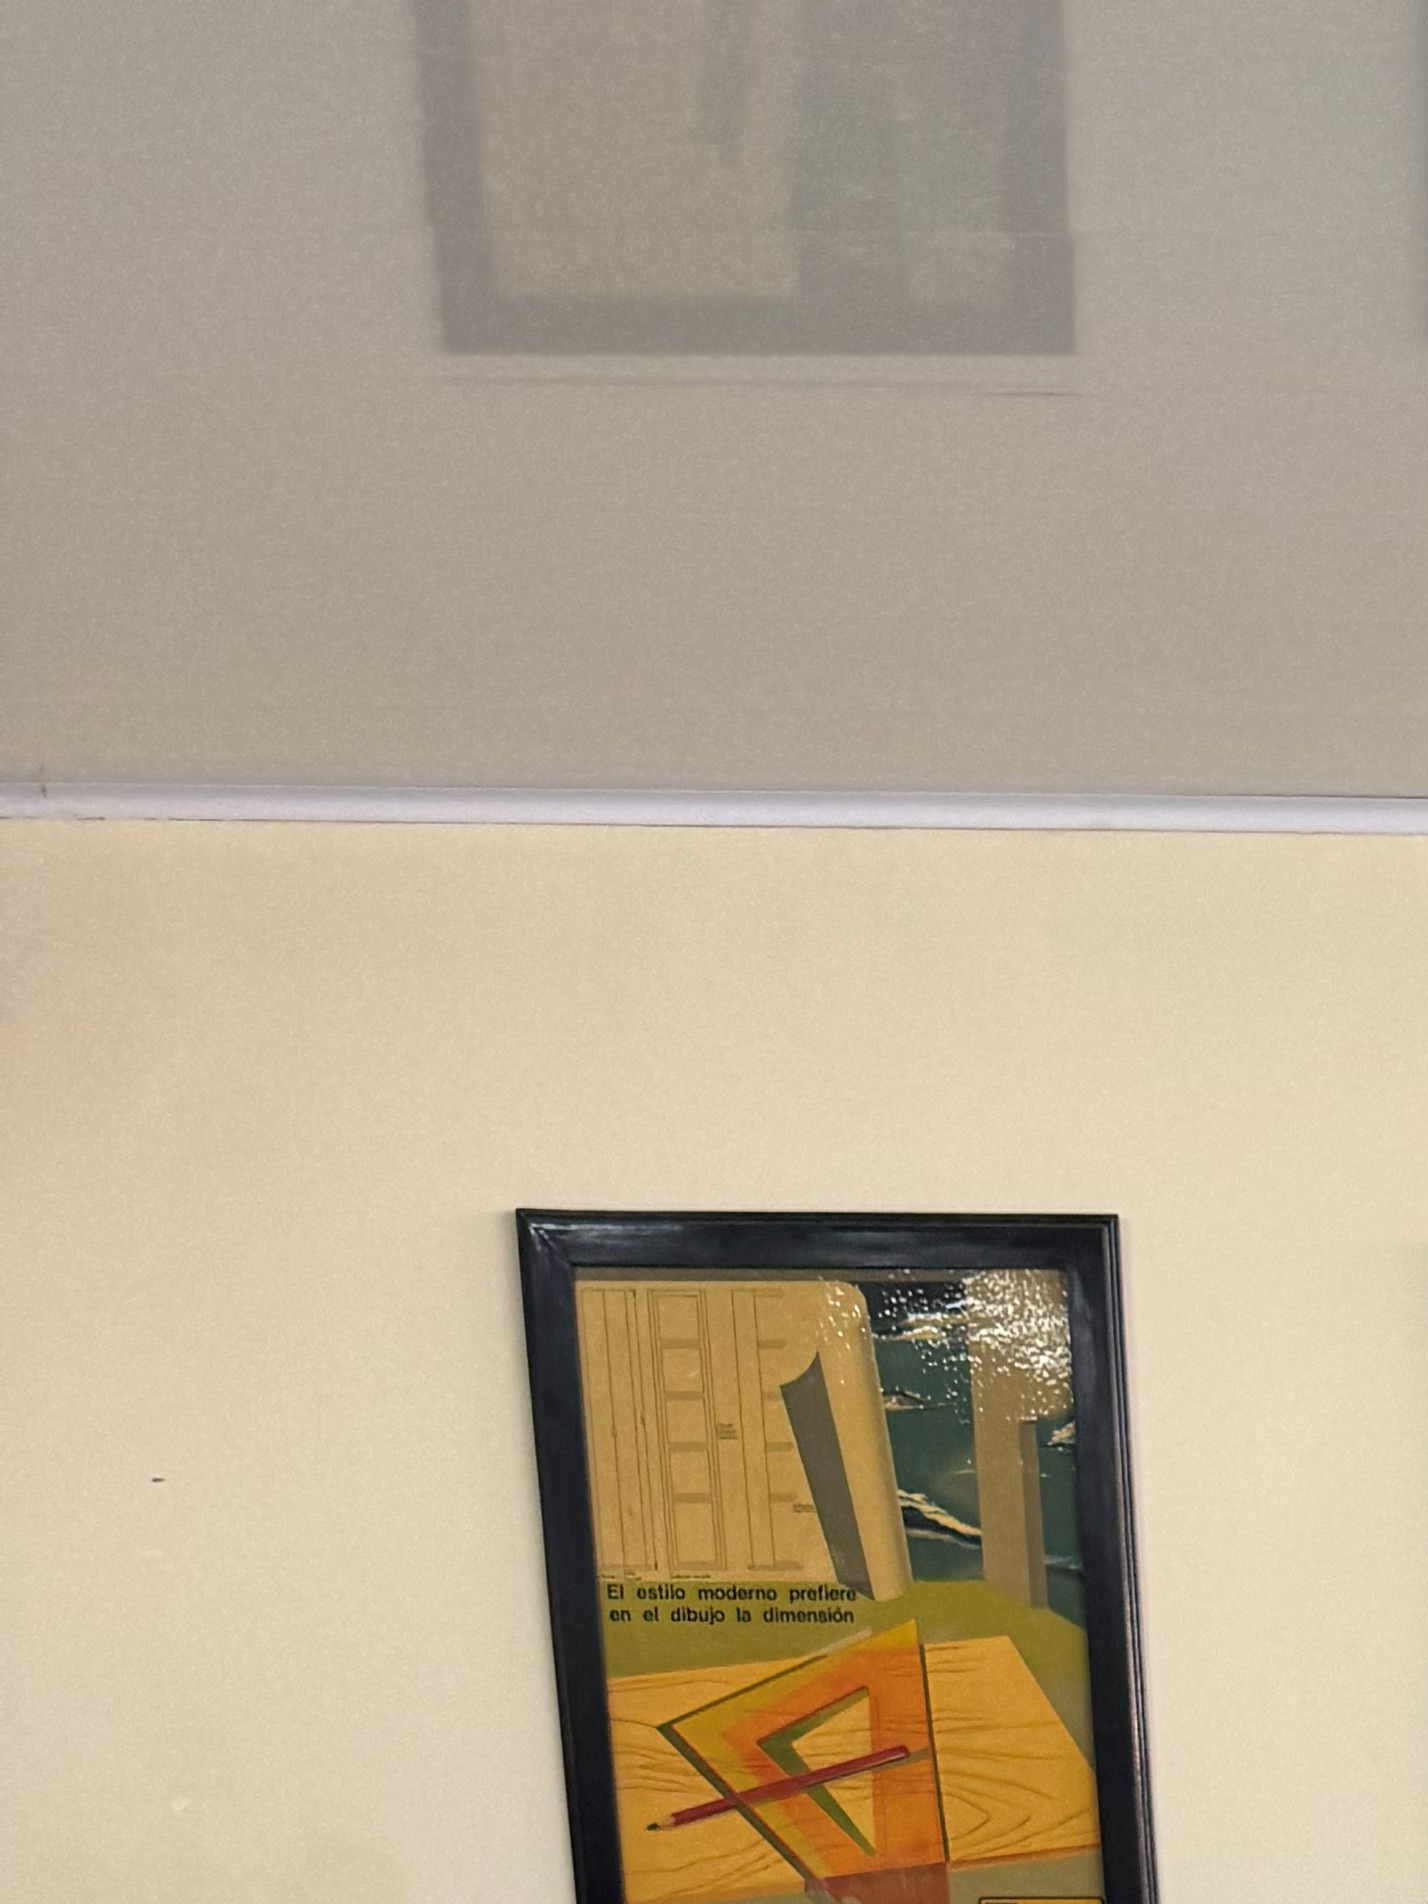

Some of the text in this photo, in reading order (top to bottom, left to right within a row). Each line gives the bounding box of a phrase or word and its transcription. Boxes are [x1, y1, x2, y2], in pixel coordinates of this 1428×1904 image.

[607, 1584, 856, 1604] El estilo moderno prefiere
[610, 1606, 854, 1625] en el dibujo la dimensión
